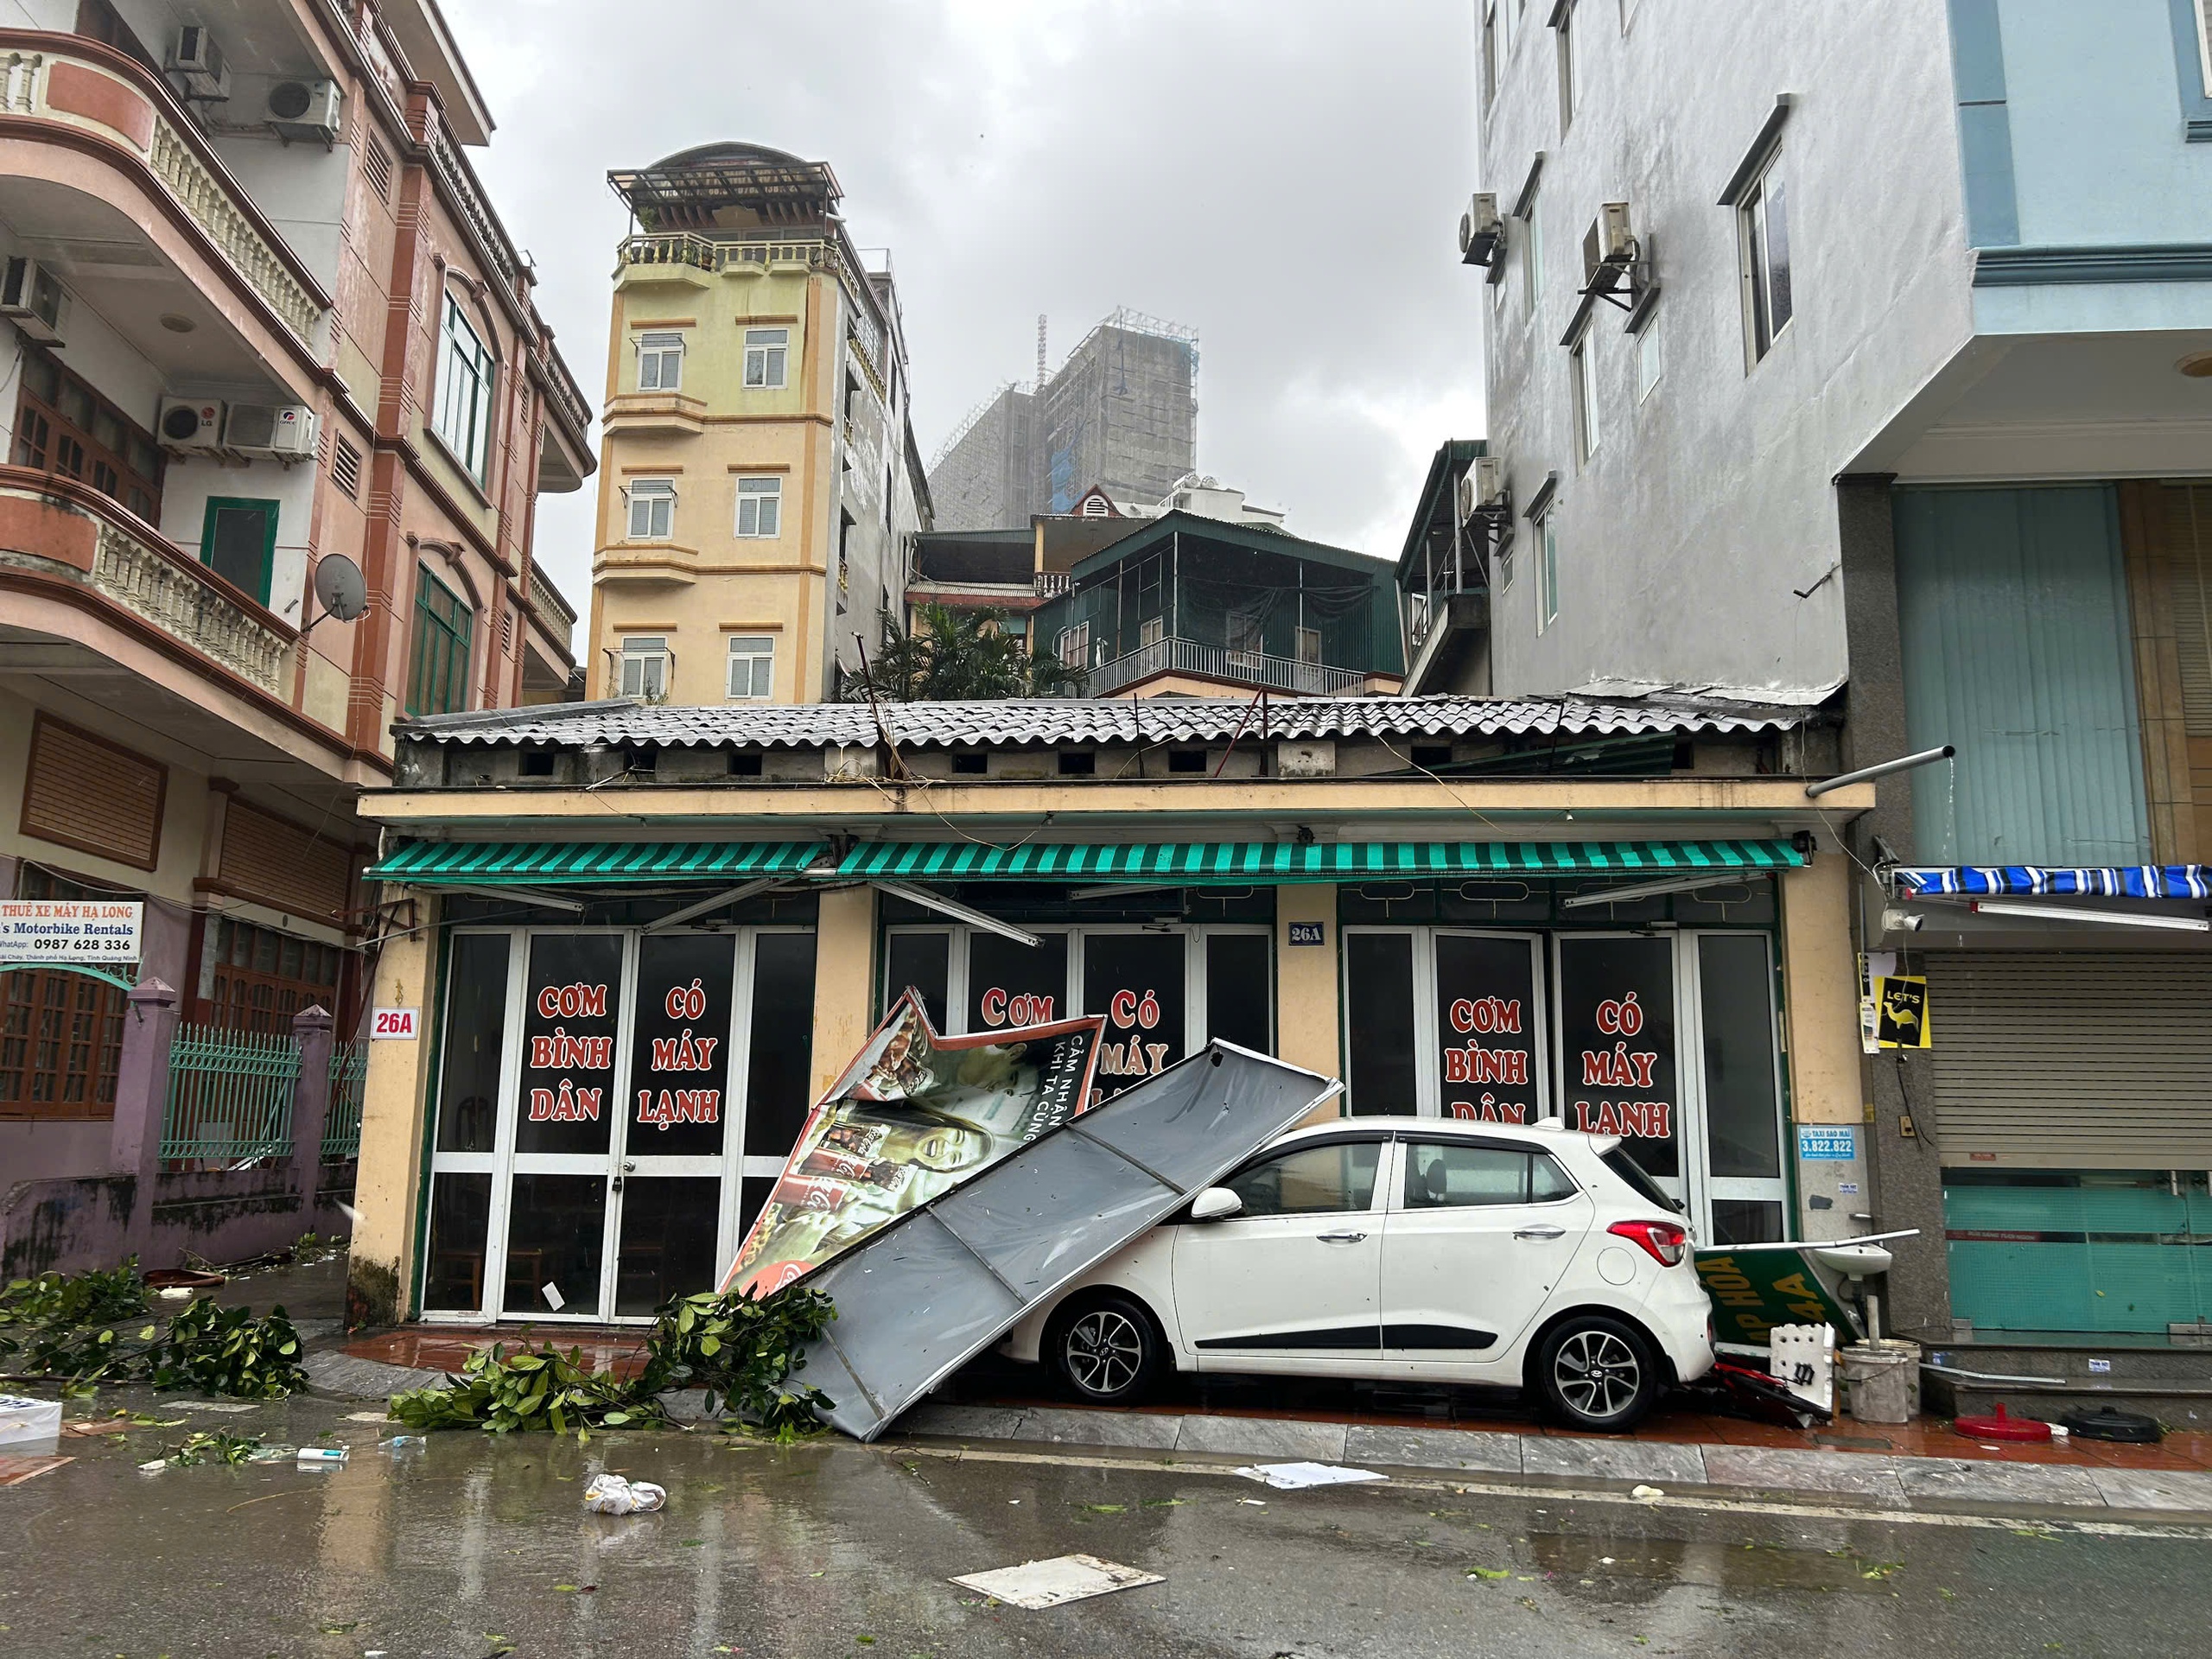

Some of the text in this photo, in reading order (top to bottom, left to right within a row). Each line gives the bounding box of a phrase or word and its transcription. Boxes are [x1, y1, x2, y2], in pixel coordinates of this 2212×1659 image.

[0, 922, 133, 935] 's Motorbike Rentals
[3, 902, 133, 921] THUÊ XE MÁY HẠ LONG
[34, 938, 68, 950] 0987
[73, 939, 99, 950] 628
[105, 940, 130, 950] 336
[1291, 927, 1322, 941] 26A
[537, 982, 607, 1019] CƠM
[664, 978, 707, 1020] CÓ
[981, 987, 1054, 1027] CƠM
[1110, 989, 1160, 1029] CÓ
[1449, 995, 1522, 1034] CƠM
[1595, 990, 1643, 1037] CÓ
[1886, 990, 1920, 1004] LET'S
[376, 1012, 412, 1034] 26A
[530, 1028, 613, 1070] BÌNH
[651, 1029, 719, 1071] MÁY
[1099, 1034, 1169, 1076] MÁY
[1444, 1038, 1529, 1085] BÌNH
[1581, 1040, 1658, 1089] MÁY
[528, 1078, 603, 1122] DÂN
[1022, 1041, 1066, 1141] KHI TA CÙNG
[1048, 1034, 1085, 1127] CẢM NHẬN
[636, 1090, 721, 1131] LẠNH
[1451, 1091, 1526, 1125] DÂN
[1802, 1140, 1853, 1152] 3.822.822
